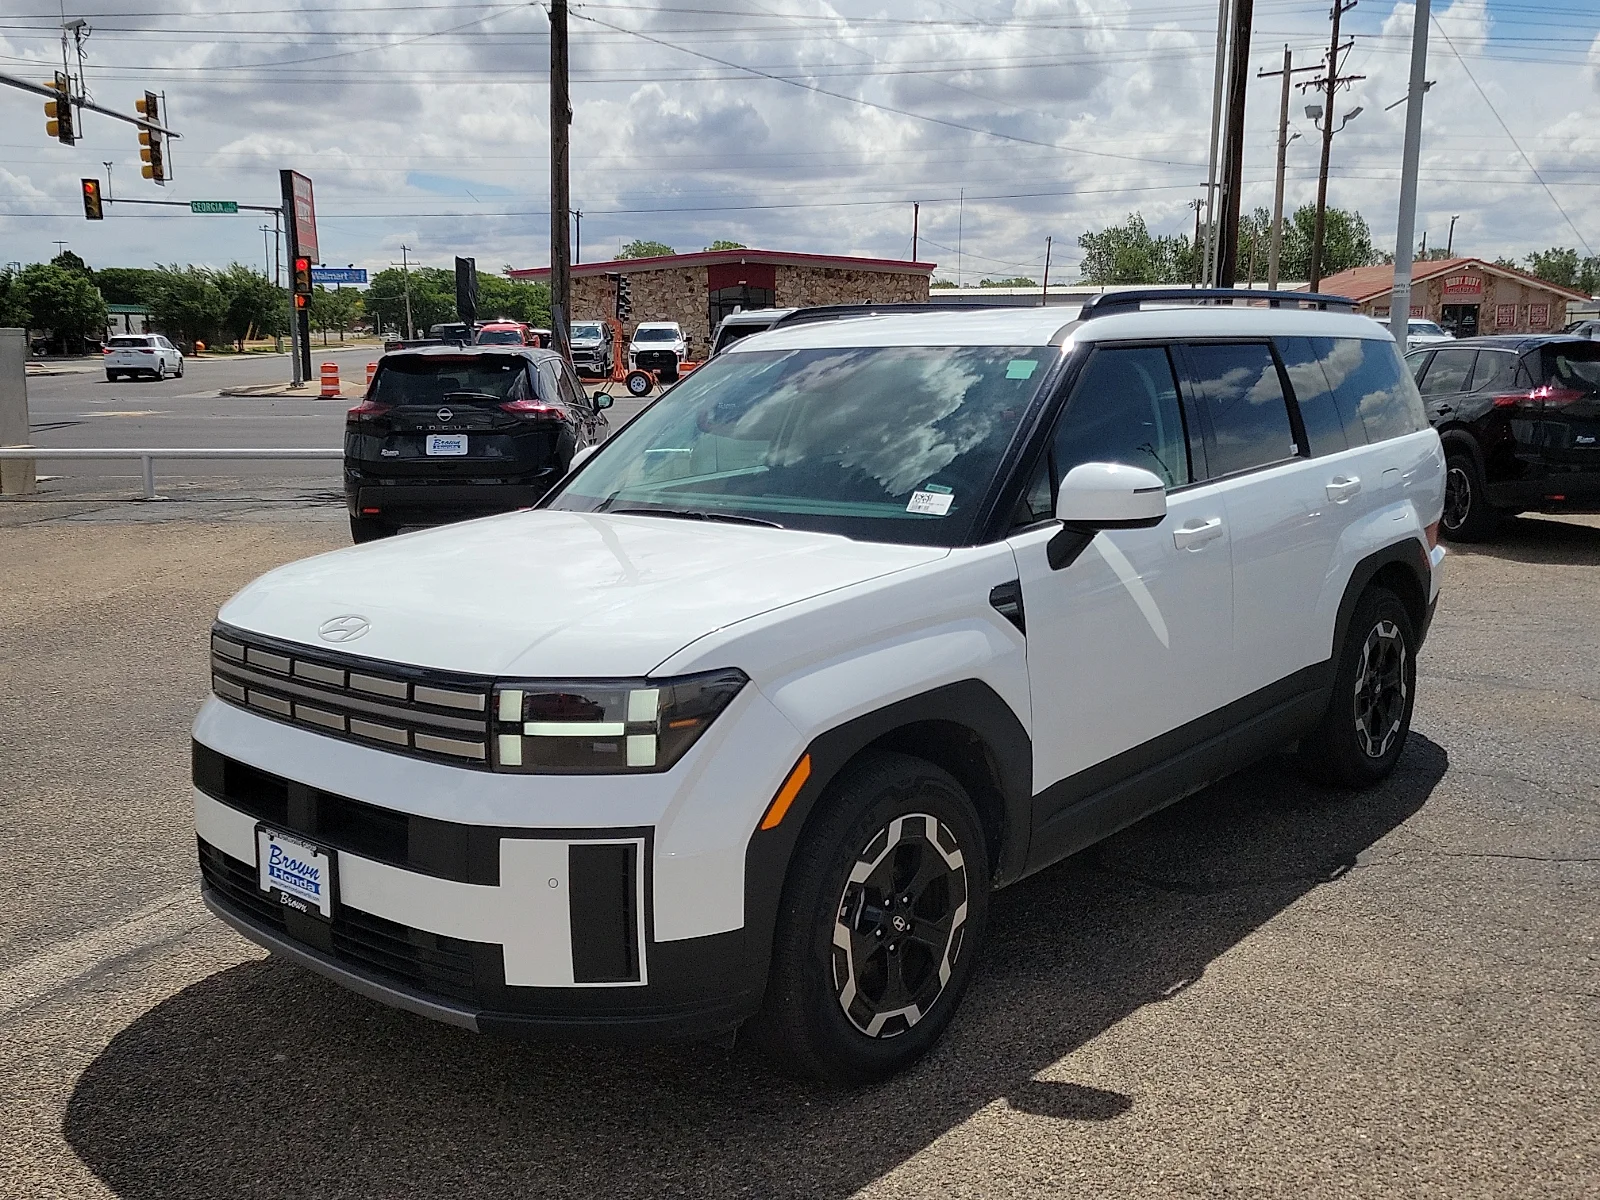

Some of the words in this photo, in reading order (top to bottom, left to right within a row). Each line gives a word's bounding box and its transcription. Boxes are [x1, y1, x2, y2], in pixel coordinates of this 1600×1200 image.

[192, 202, 224, 212] GEORGIA
[311, 271, 348, 281] Walmart
[269, 844, 320, 880] Brown
[272, 867, 316, 893] Honda
[280, 891, 308, 912] Brown
